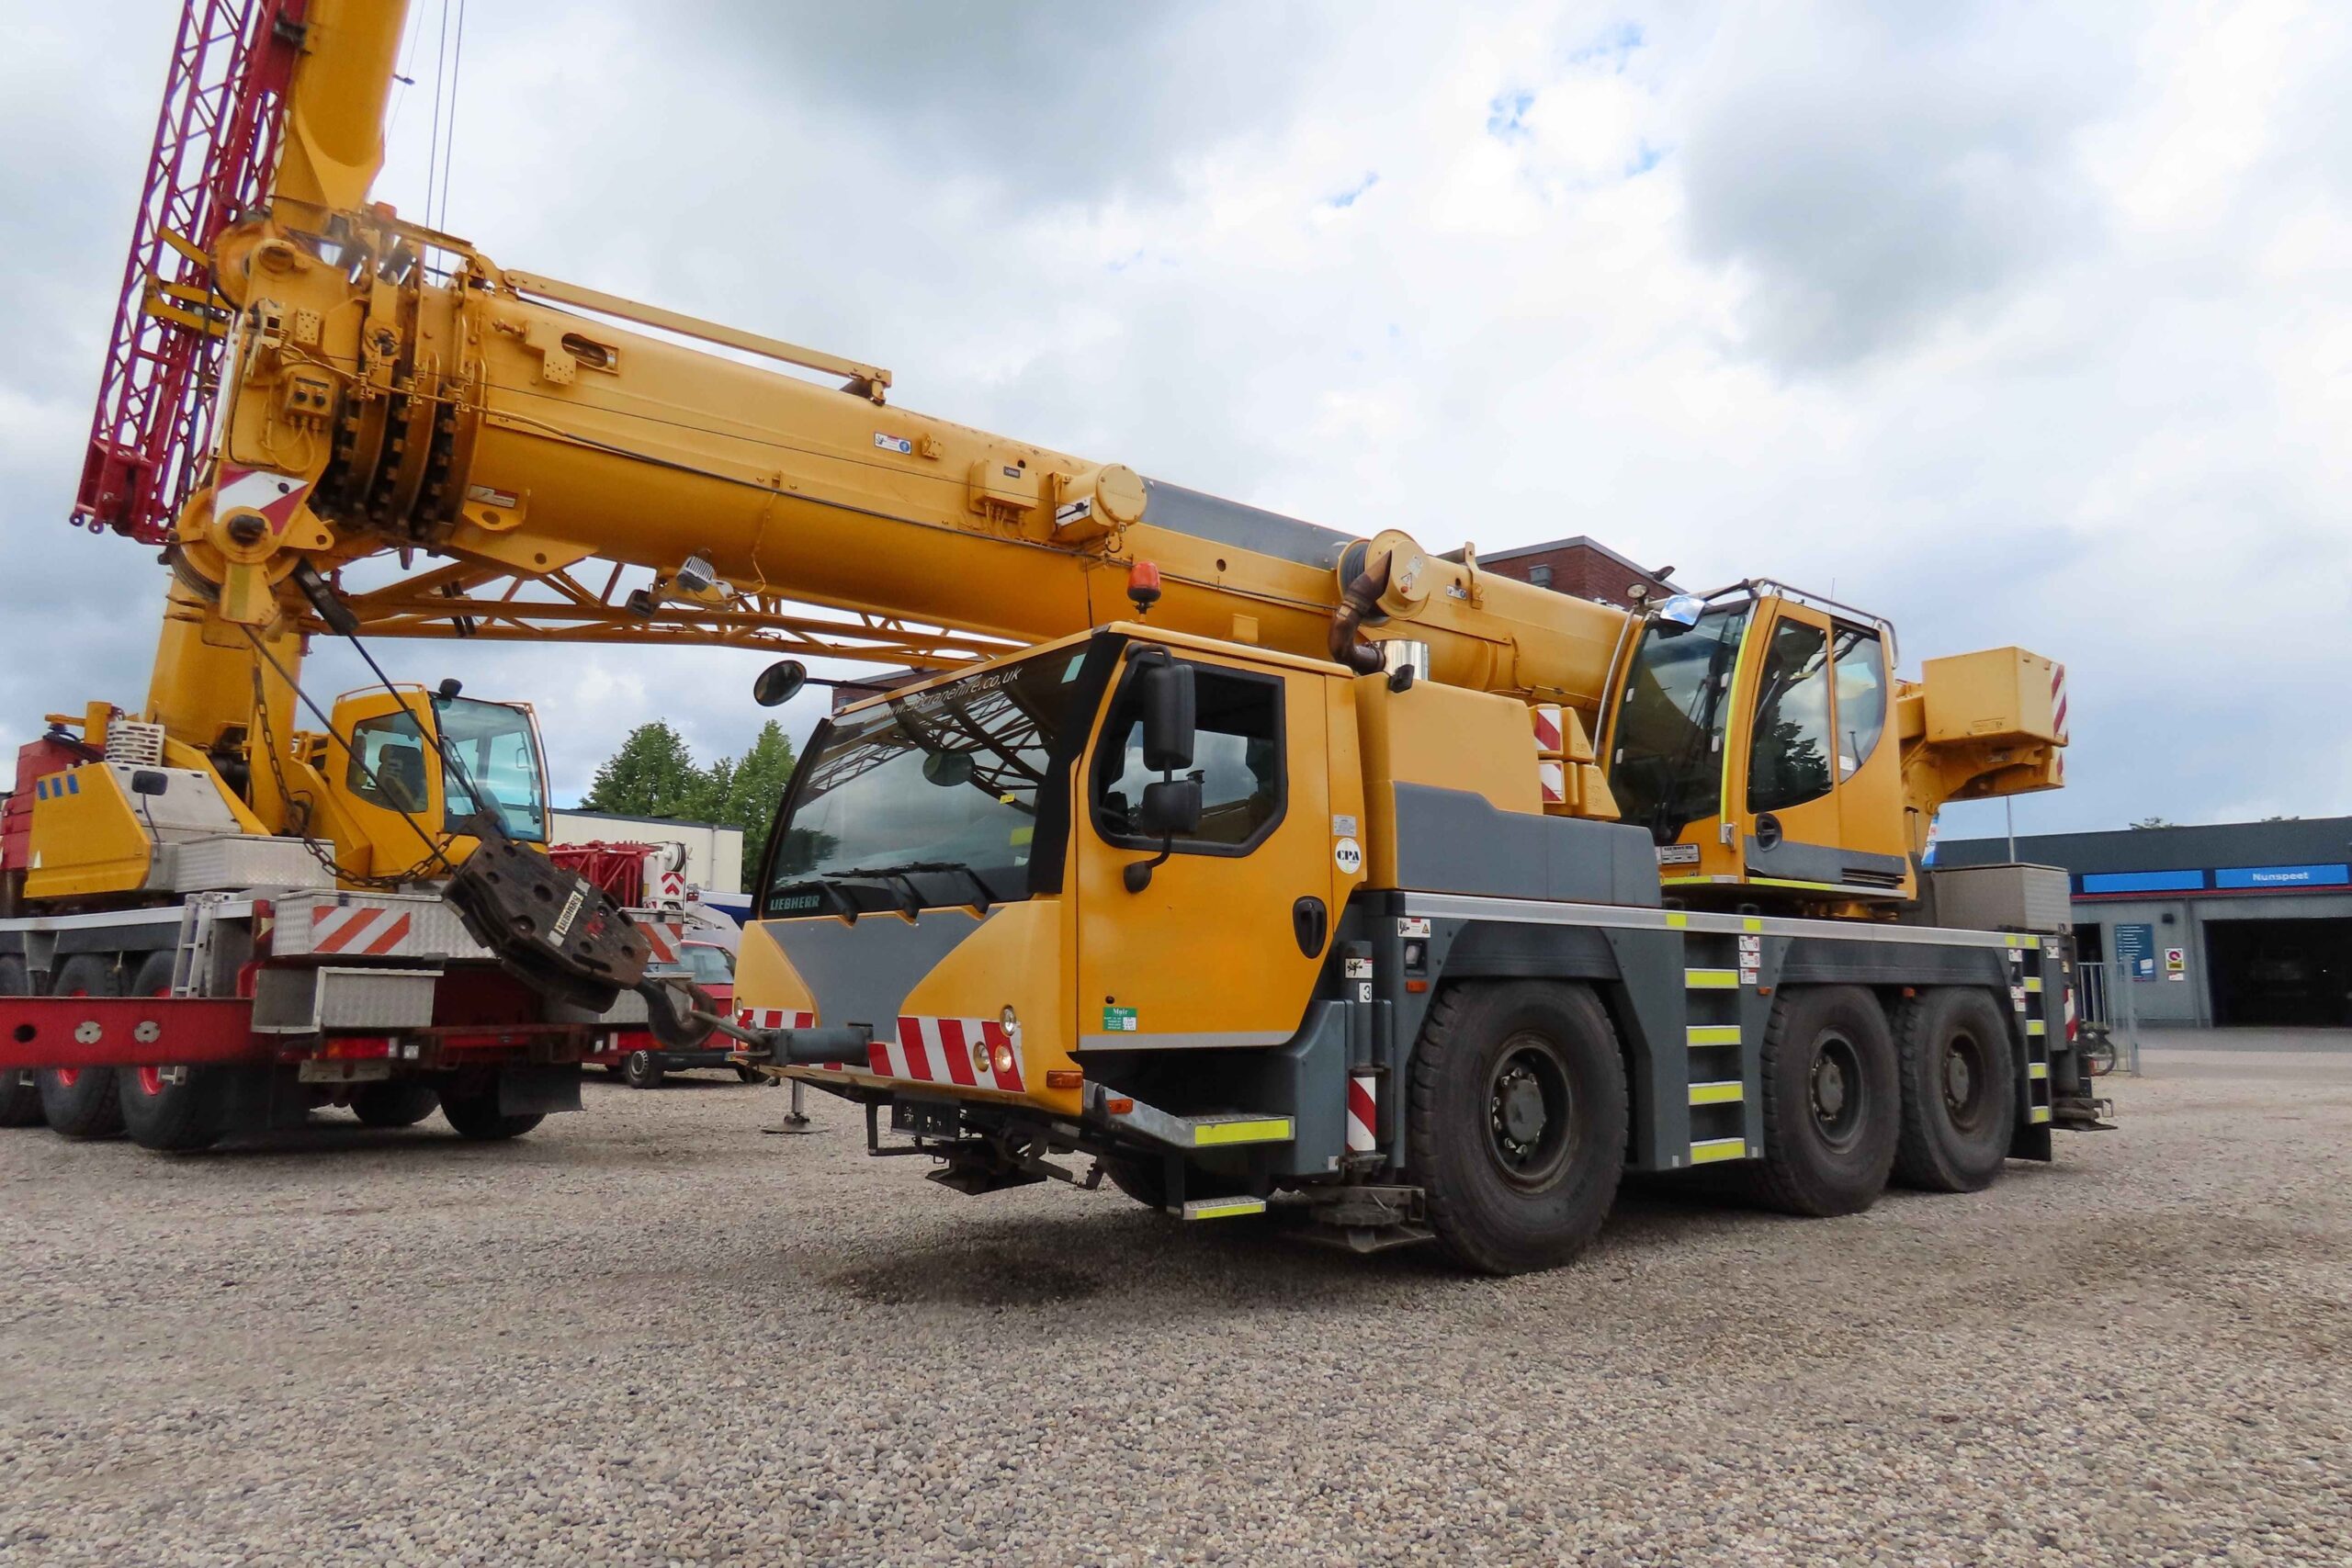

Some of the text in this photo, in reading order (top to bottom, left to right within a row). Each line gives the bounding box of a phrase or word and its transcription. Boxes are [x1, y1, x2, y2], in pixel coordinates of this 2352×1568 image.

[1337, 850, 1360, 861] CPA
[2252, 873, 2309, 882] Nunspeet
[770, 895, 820, 910] LIEBHERR
[1363, 985, 1371, 1000] 3
